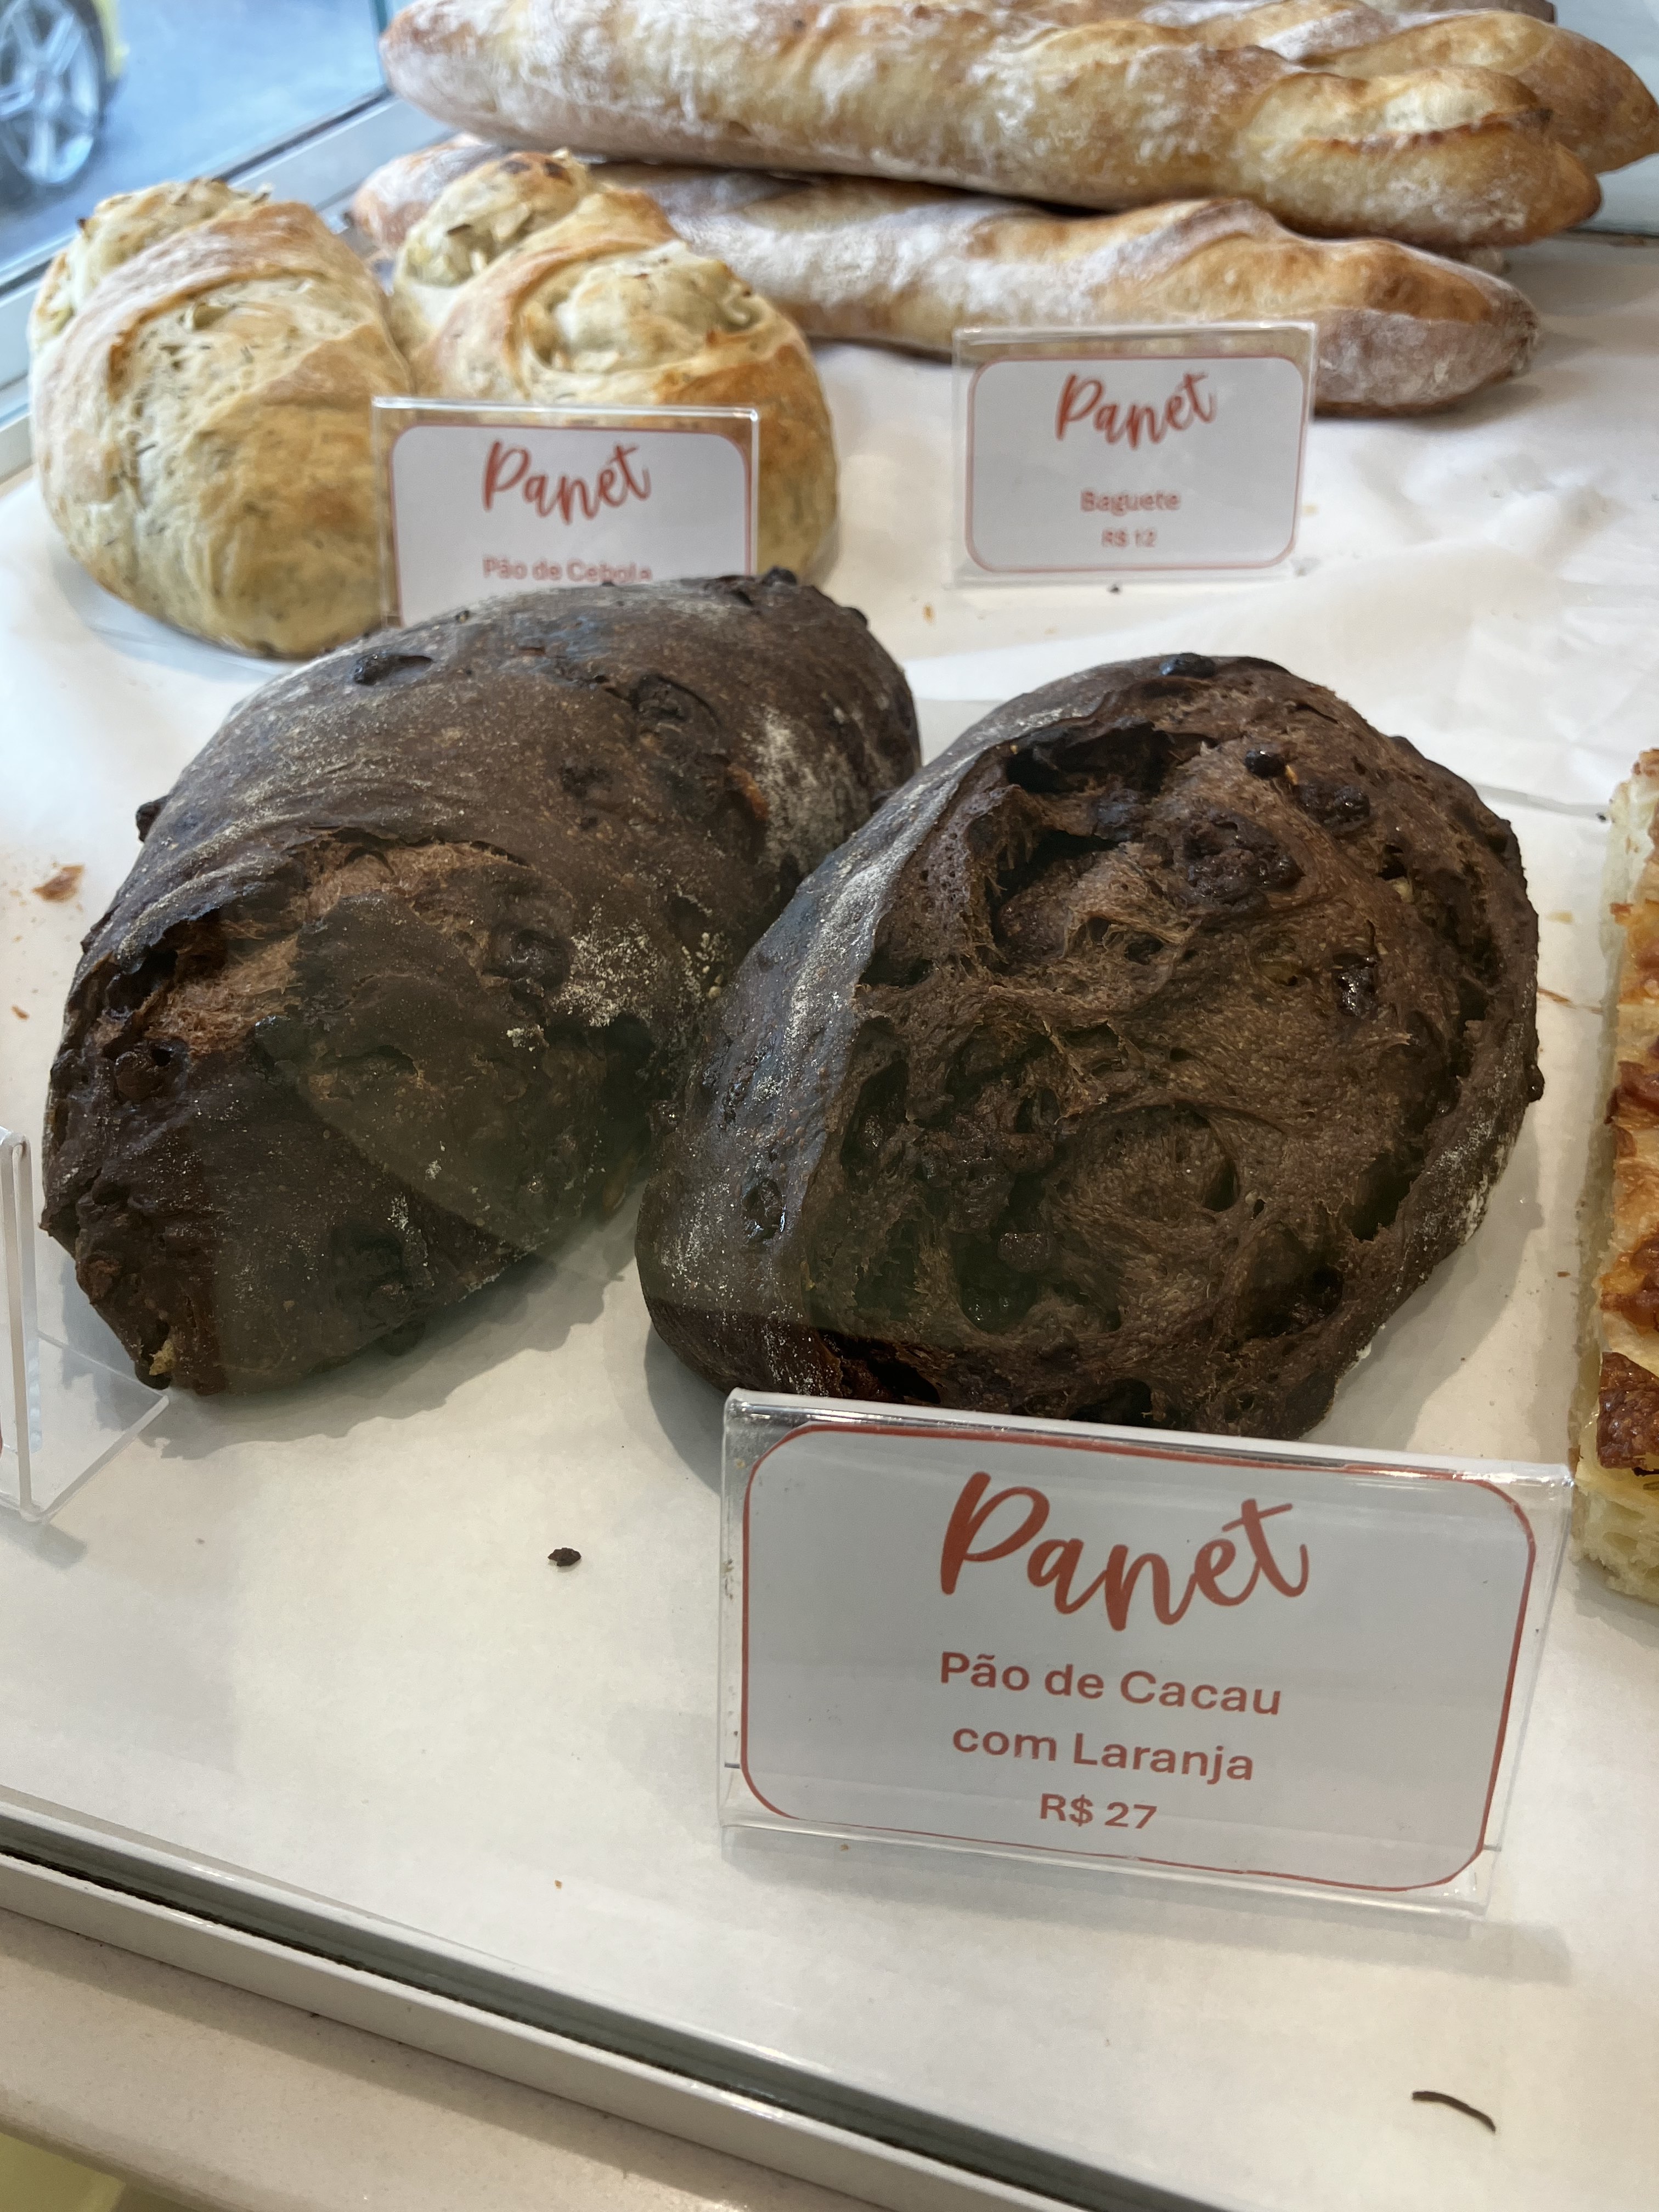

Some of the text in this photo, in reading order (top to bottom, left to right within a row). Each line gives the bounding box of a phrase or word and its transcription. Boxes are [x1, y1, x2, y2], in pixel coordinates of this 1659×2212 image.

[1055, 373, 1215, 449] Panet
[482, 441, 651, 524] Panet
[1080, 488, 1180, 517] Baguete
[1102, 528, 1156, 548] R$ 12
[483, 555, 651, 582] Pão de Cebola
[940, 1471, 1310, 1632] Panet
[941, 1651, 1280, 1716] Pão de Cacau
[953, 1729, 1253, 1785] com Laranja
[1040, 1793, 1157, 1829] R$ 27
